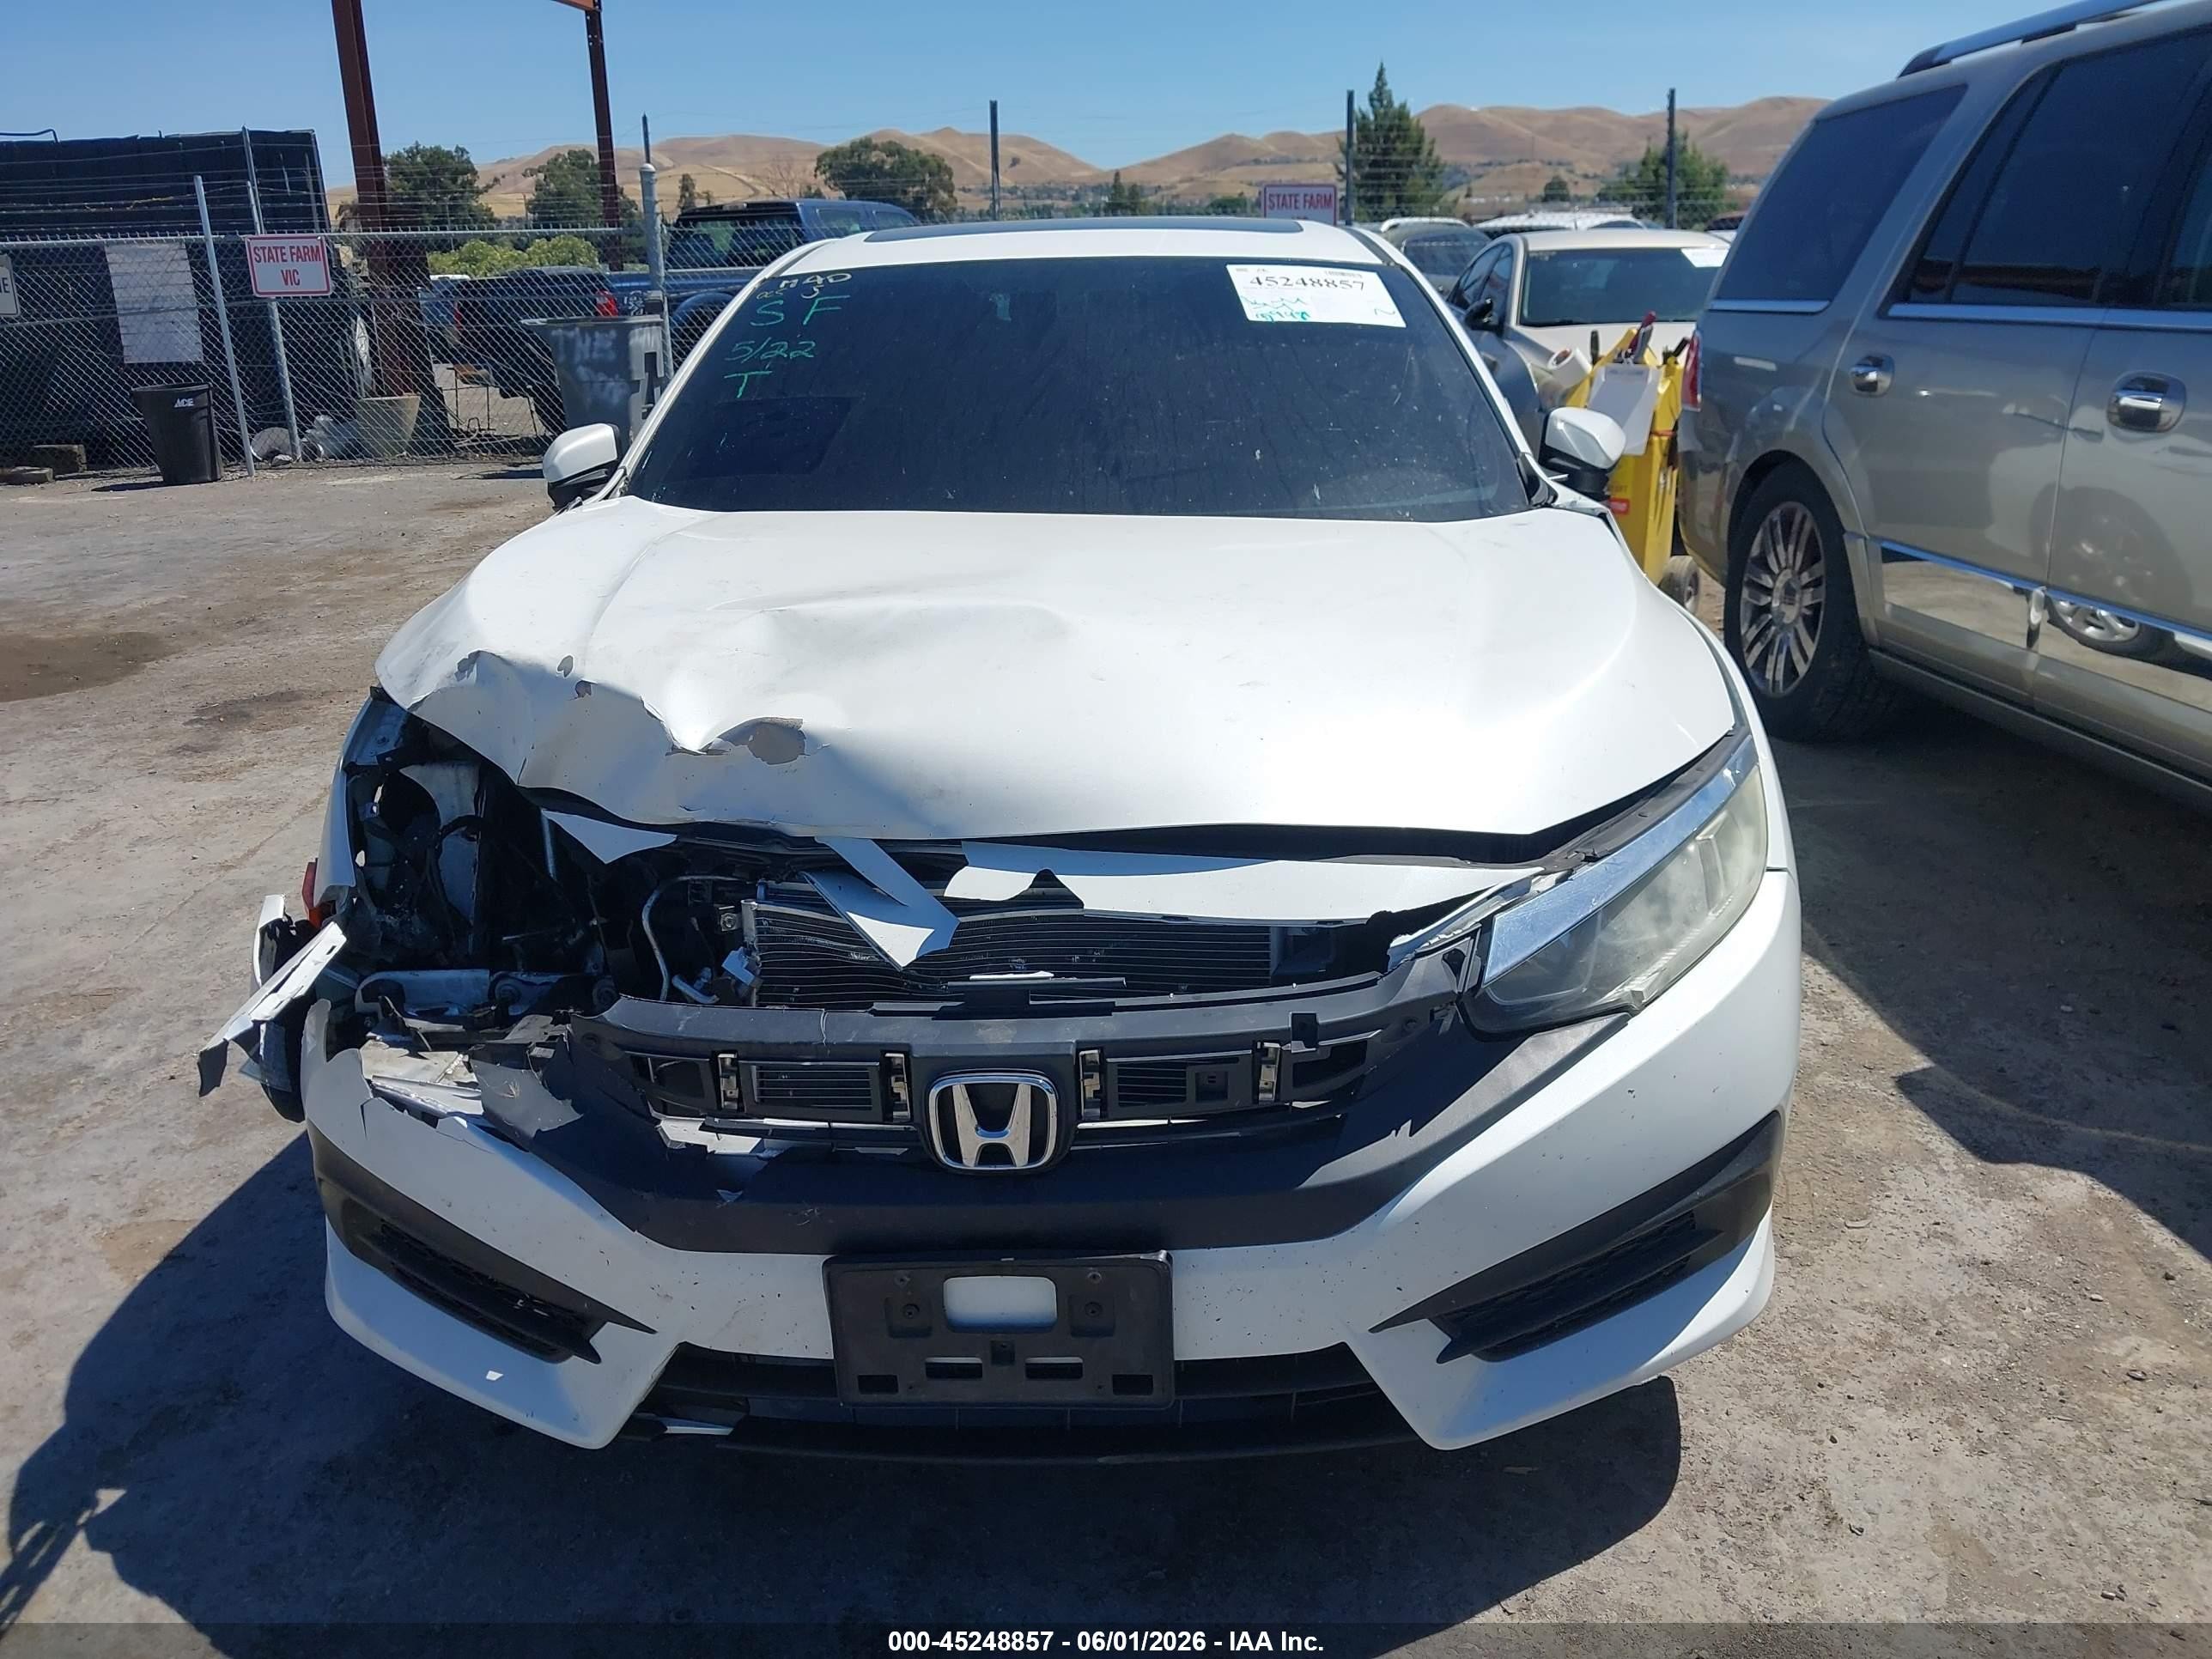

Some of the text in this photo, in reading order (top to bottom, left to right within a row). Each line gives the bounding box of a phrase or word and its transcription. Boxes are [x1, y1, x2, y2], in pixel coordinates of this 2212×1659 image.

[1268, 192, 1334, 210] STATE FARM
[253, 245, 322, 264] STATE FARM
[281, 268, 301, 286] VIC
[1249, 276, 1365, 291] 45248857
[173, 398, 195, 408] ACE
